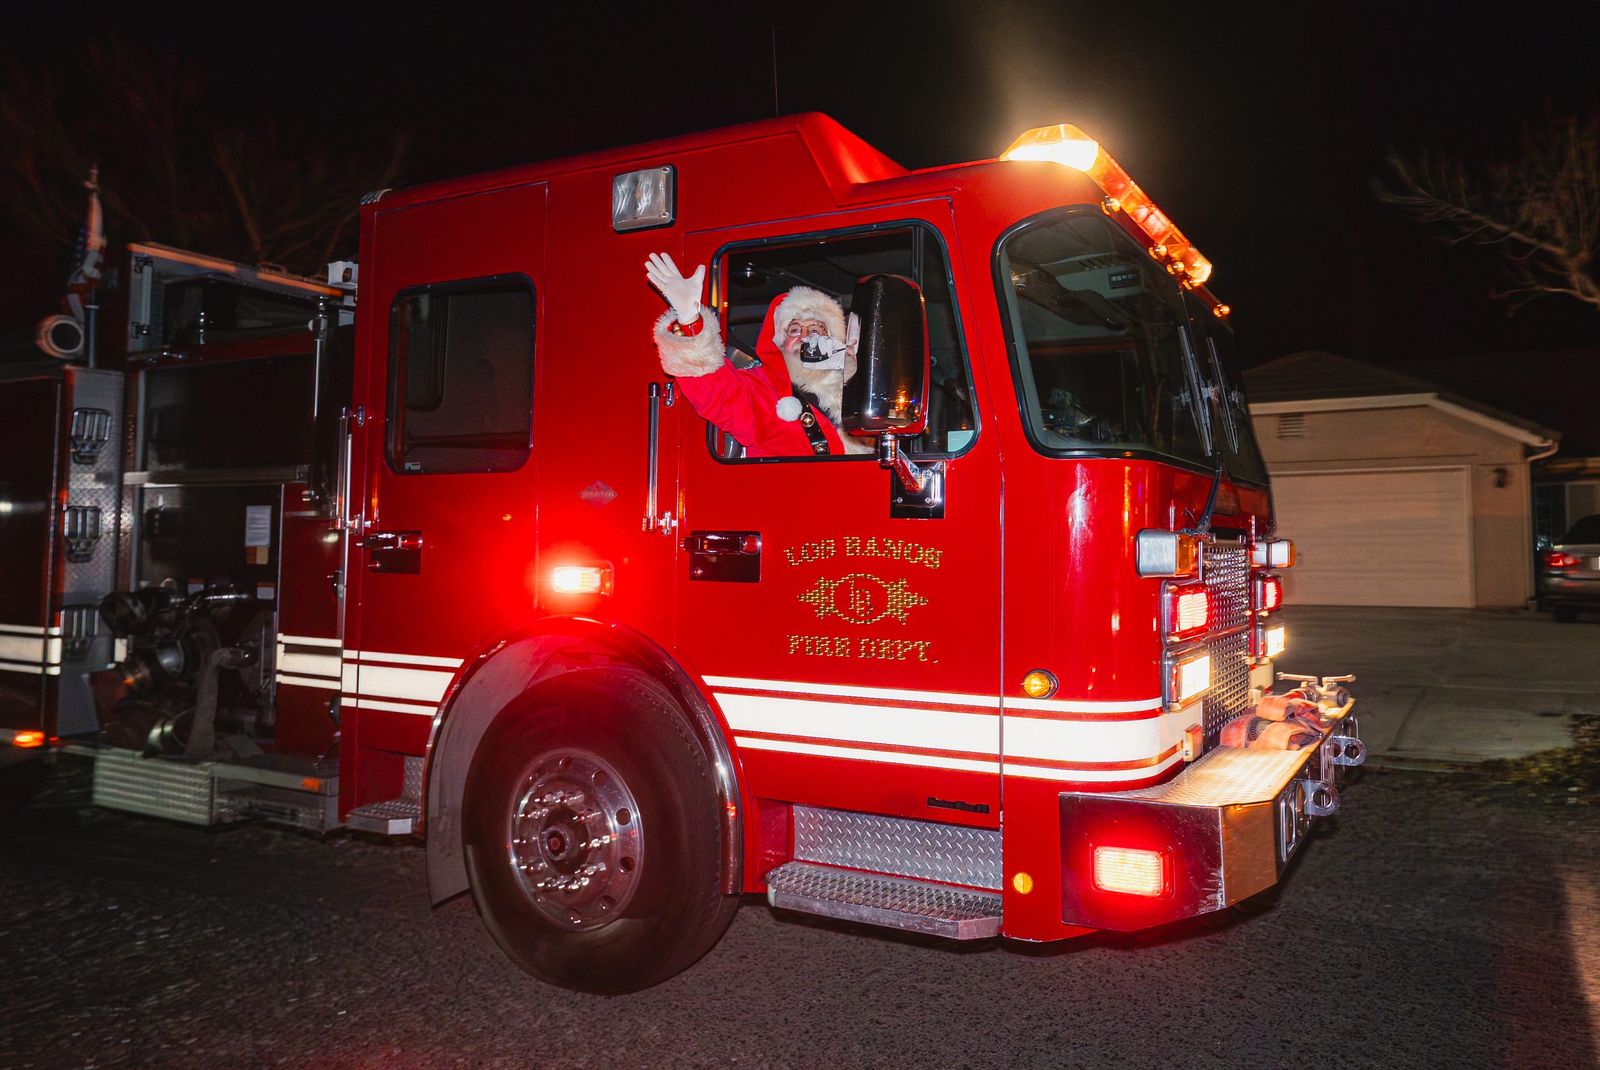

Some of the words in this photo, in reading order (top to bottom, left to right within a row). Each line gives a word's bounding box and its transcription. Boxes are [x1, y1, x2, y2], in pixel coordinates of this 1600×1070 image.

[784, 539, 836, 567] LOS
[843, 536, 944, 570] BANOS
[786, 634, 851, 658] FIRE
[857, 637, 939, 665] DEPT.
